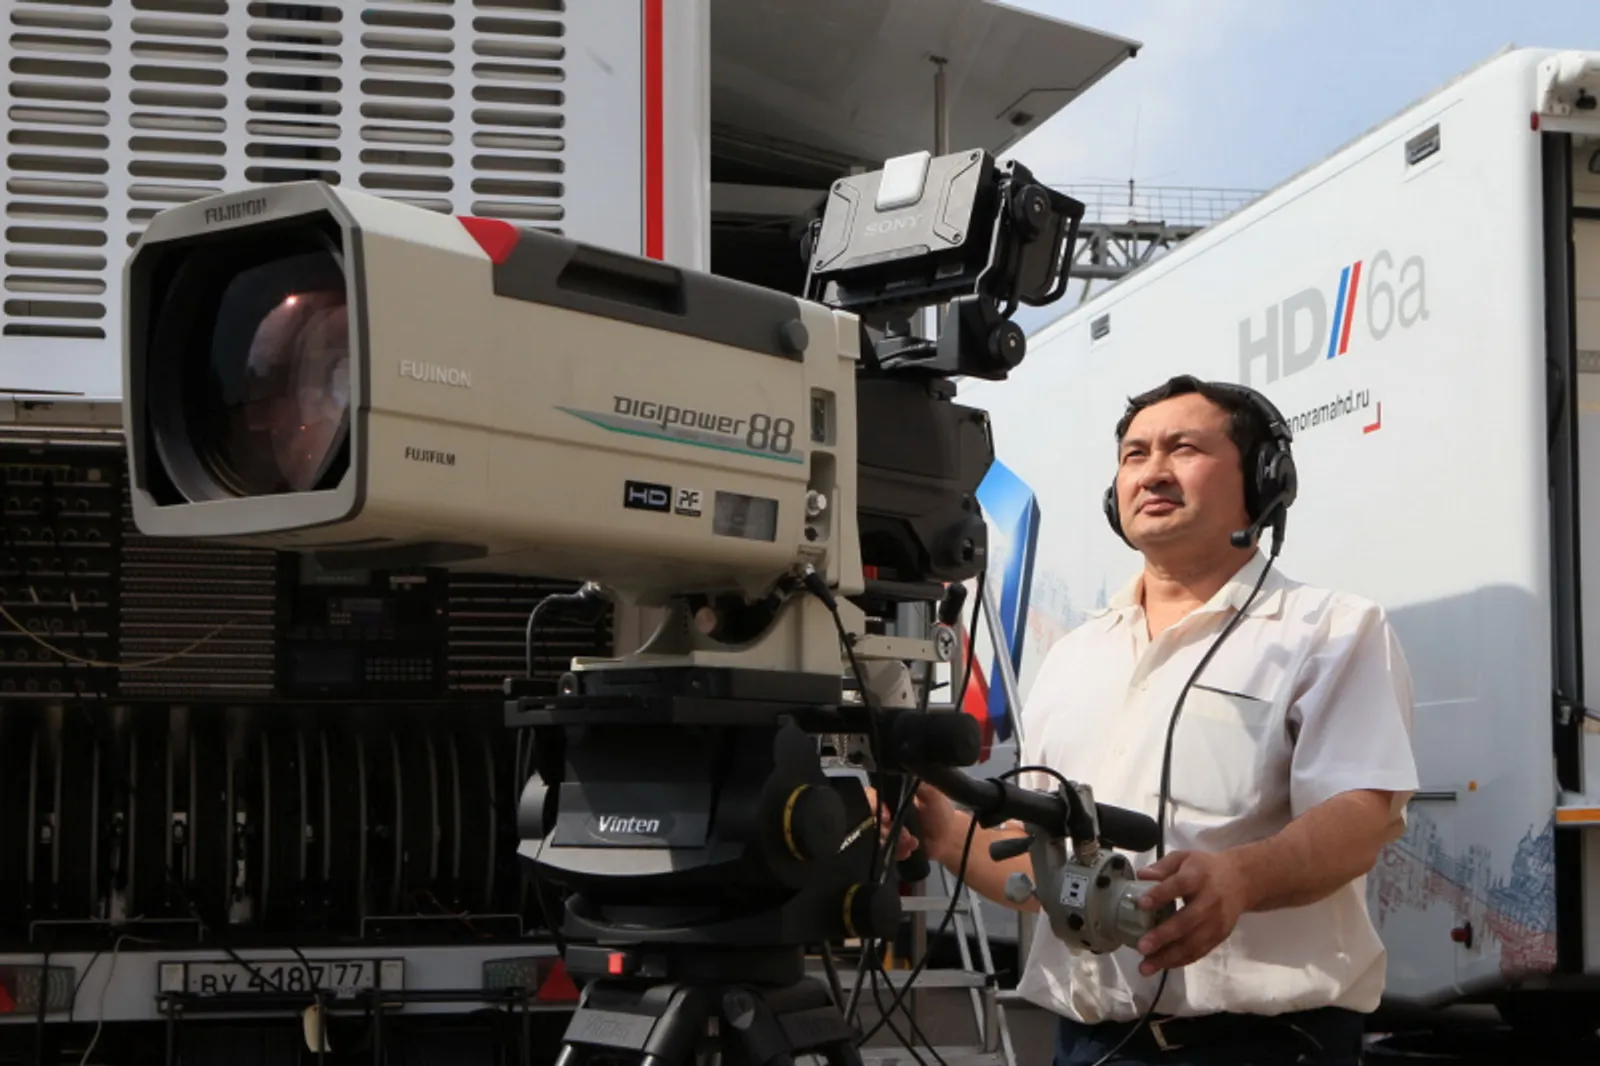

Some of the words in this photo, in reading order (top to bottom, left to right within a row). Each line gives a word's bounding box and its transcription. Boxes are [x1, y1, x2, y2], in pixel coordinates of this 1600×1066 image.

[864, 212, 923, 237] SONY
[399, 359, 472, 389] FUJINON
[1286, 388, 1370, 433] anoramahd.ru
[404, 445, 456, 466] FUJIFILM
[628, 485, 668, 506] HD
[599, 815, 660, 833] Vinten
[334, 964, 365, 986] 77
